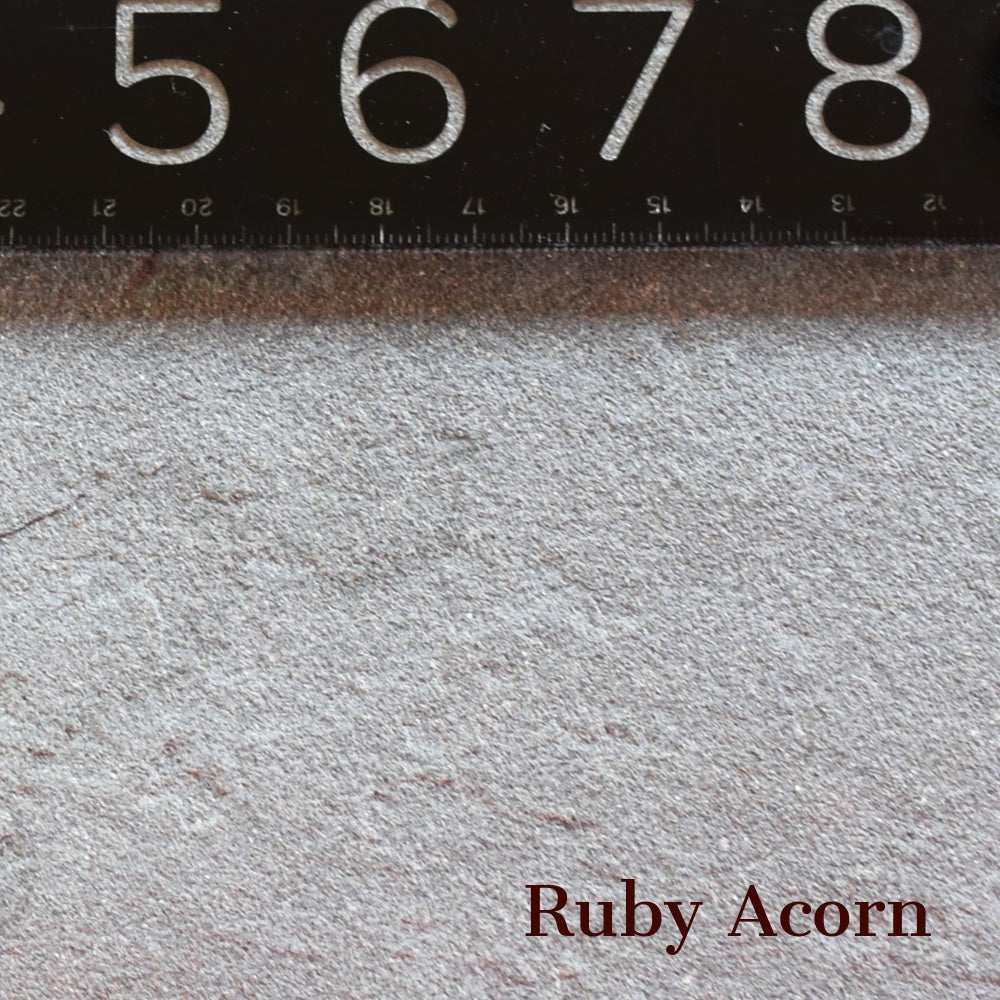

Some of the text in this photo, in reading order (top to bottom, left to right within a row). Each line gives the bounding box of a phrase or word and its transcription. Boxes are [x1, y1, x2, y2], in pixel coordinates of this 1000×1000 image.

[90, 199, 117, 215] 21
[180, 198, 211, 214] 20
[274, 198, 302, 214] 19
[367, 198, 395, 213] 18
[460, 198, 487, 213] 17
[554, 197, 580, 213] 16
[646, 197, 672, 212] 15
[739, 197, 764, 212] 14
[831, 196, 855, 211] 13
[923, 196, 947, 211] 12
